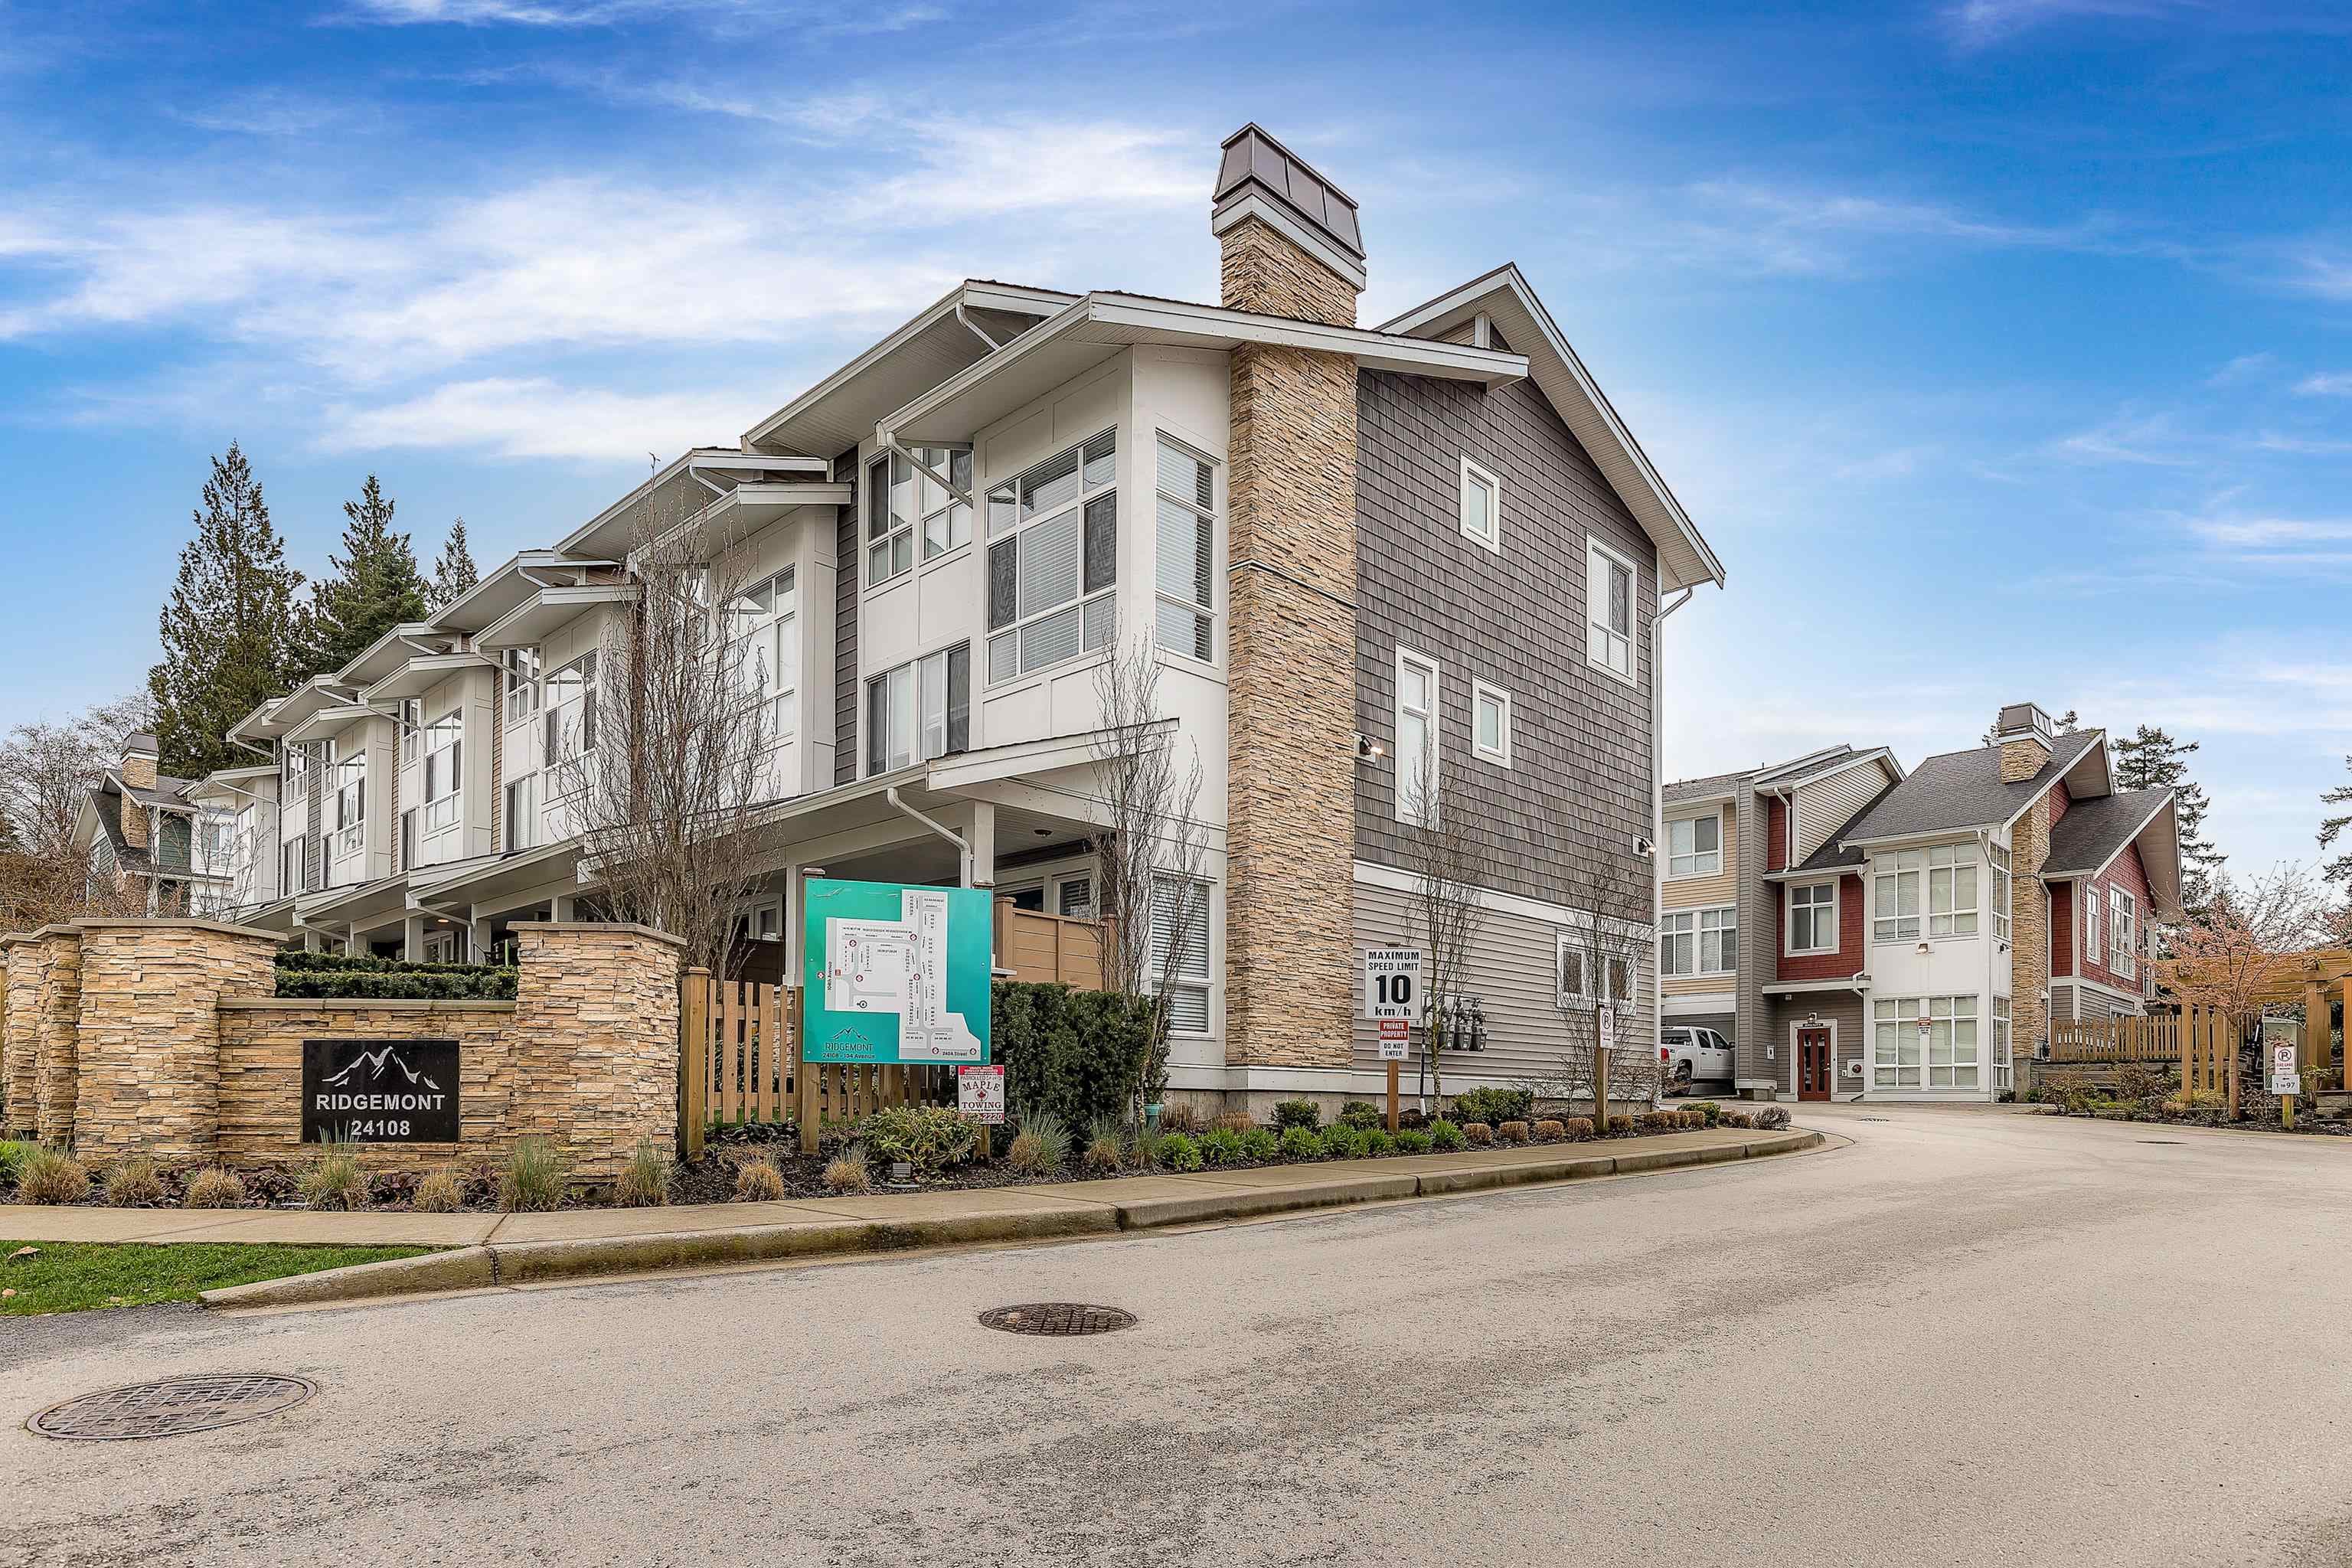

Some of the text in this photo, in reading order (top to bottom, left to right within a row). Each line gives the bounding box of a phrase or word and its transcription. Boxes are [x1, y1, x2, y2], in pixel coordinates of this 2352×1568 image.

[1368, 951, 1419, 960] MAXIMUM
[1368, 962, 1419, 971] SPEED LIMIT
[1375, 975, 1411, 1004] 10
[1375, 1005, 1411, 1017] km/h
[825, 1042, 874, 1051] RIDGEMONT
[962, 1080, 1001, 1092] MAPLE
[316, 1094, 446, 1110] RIDGEMONT
[351, 1120, 410, 1135] 24108
